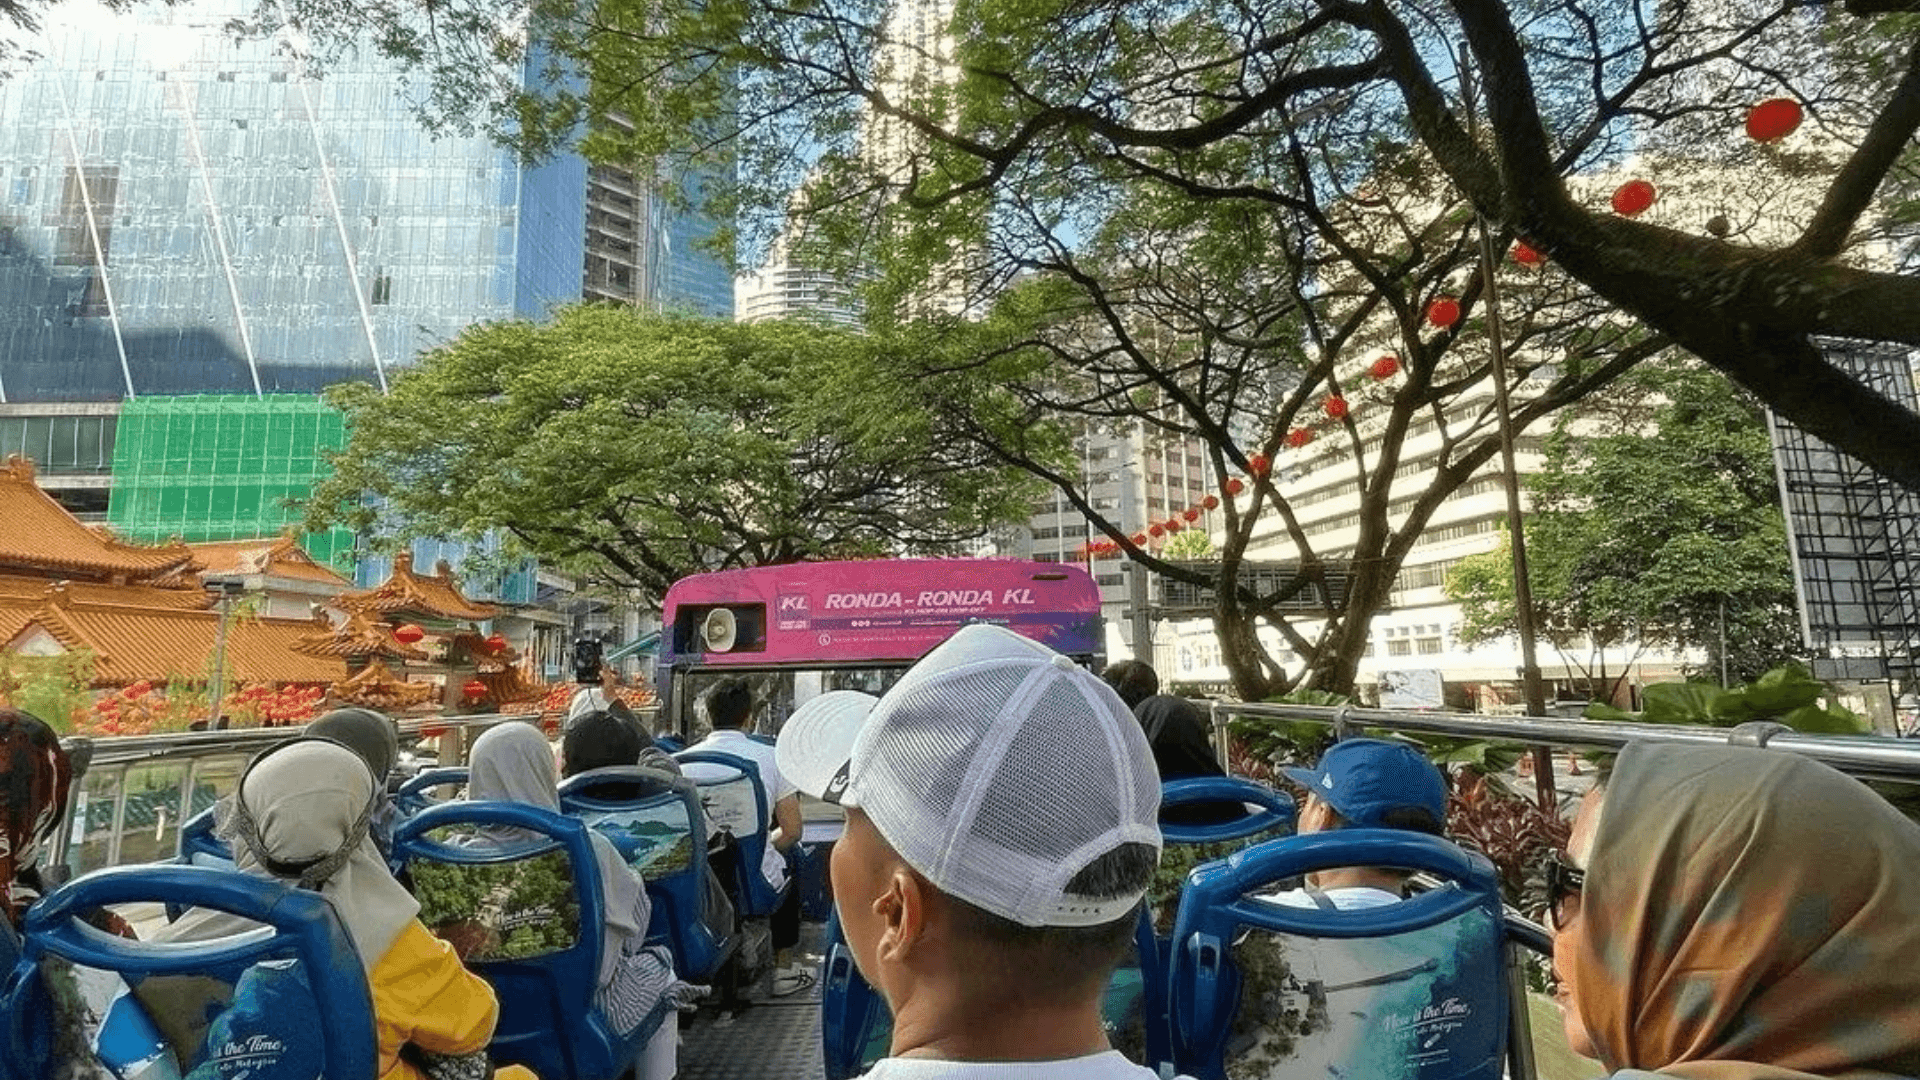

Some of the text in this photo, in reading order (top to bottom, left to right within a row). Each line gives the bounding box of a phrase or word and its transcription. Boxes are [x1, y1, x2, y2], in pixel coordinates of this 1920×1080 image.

[780, 597, 808, 610] KL
[1002, 589, 1035, 604] KL
[1384, 1013, 1410, 1031] Now
[1423, 1005, 1441, 1019] the
[224, 1041, 245, 1056] the
[245, 1034, 287, 1054] Time,
